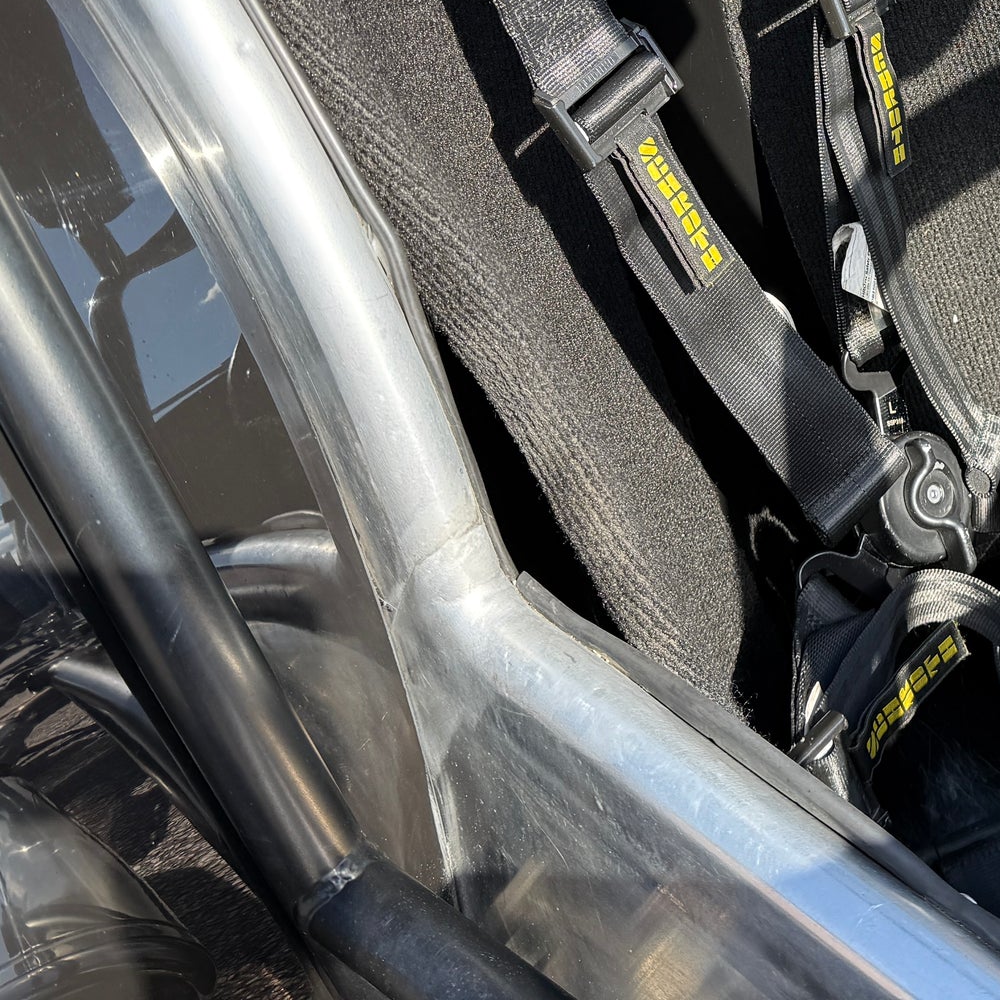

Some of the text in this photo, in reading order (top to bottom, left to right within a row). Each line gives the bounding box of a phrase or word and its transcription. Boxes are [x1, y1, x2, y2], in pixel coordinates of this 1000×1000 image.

[871, 32, 907, 166] SCHROTH
[638, 136, 723, 272] SCHROTH
[866, 635, 958, 760] SCHROTH
